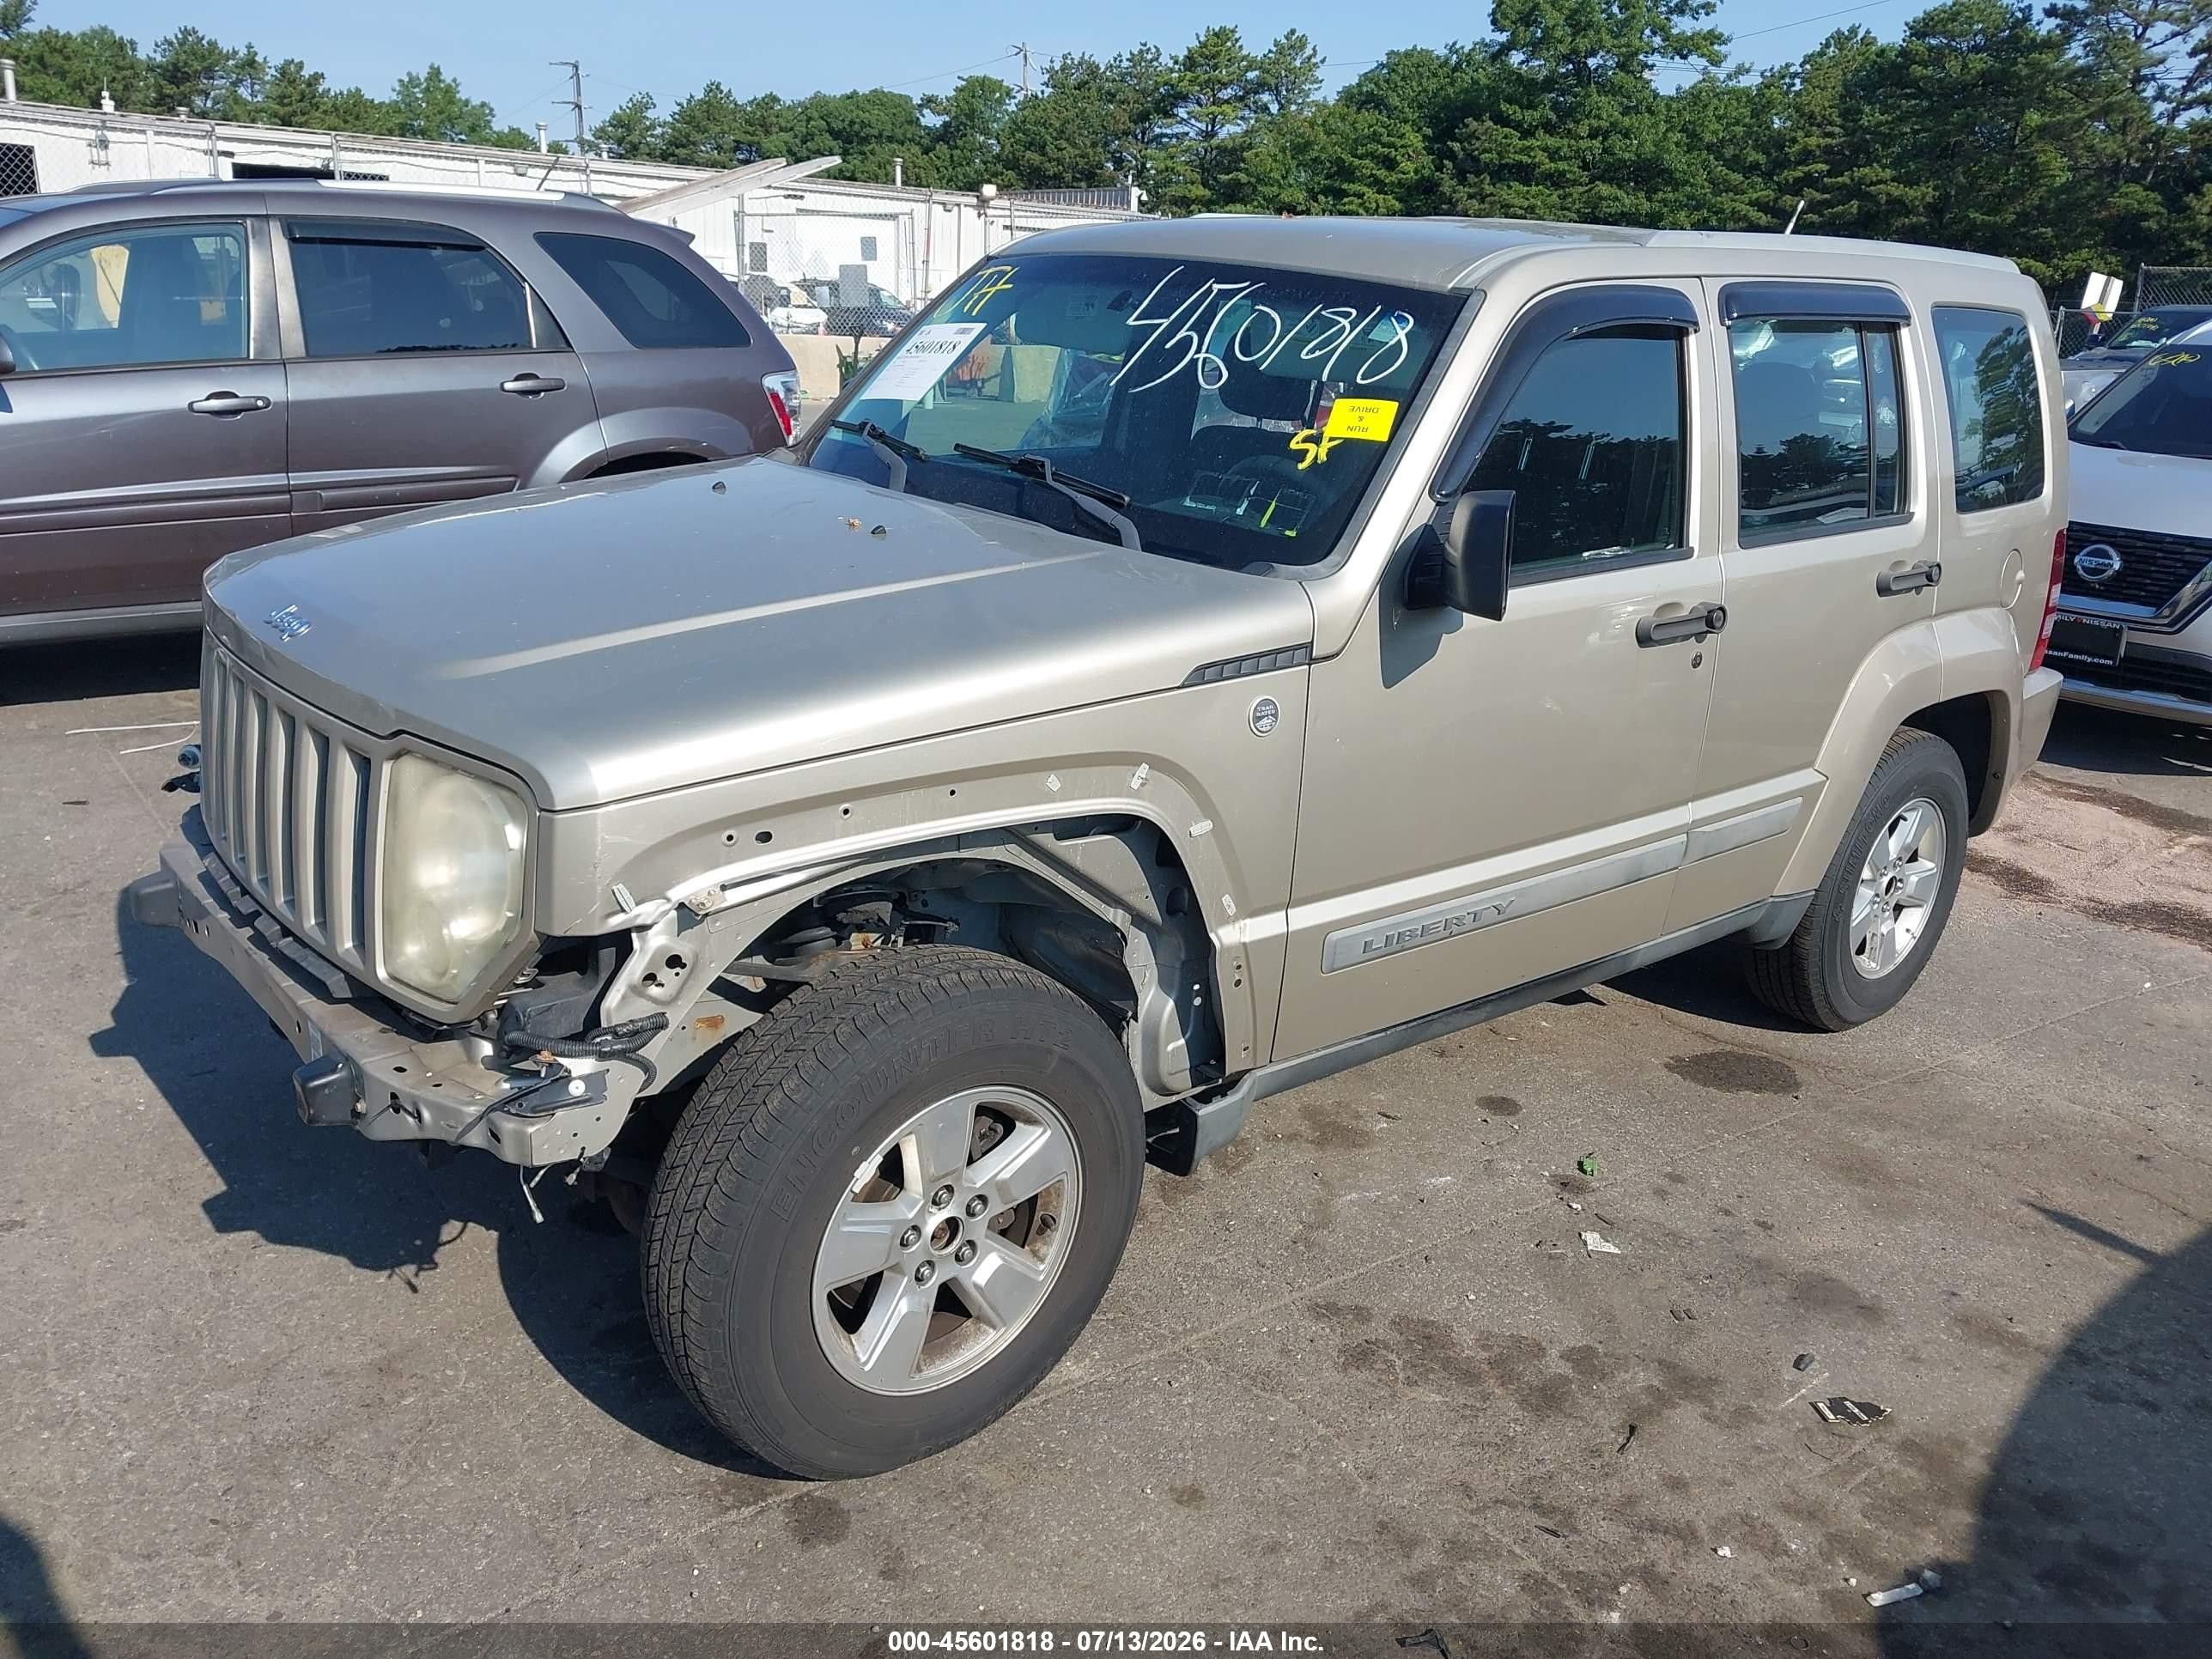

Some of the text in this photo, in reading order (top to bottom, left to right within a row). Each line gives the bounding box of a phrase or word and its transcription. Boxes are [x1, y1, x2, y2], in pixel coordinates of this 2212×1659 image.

[1110, 265, 1414, 392] 45601818
[906, 340, 962, 355] 45601818
[1348, 405, 1379, 414] DRIVE
[2077, 556, 2114, 568] NISSAN
[2082, 617, 2120, 629] NISSAN
[2044, 649, 2113, 665] sanFamily.com
[1362, 896, 1516, 955] LIBERTY
[769, 1018, 996, 1223] ENCOUNTER
